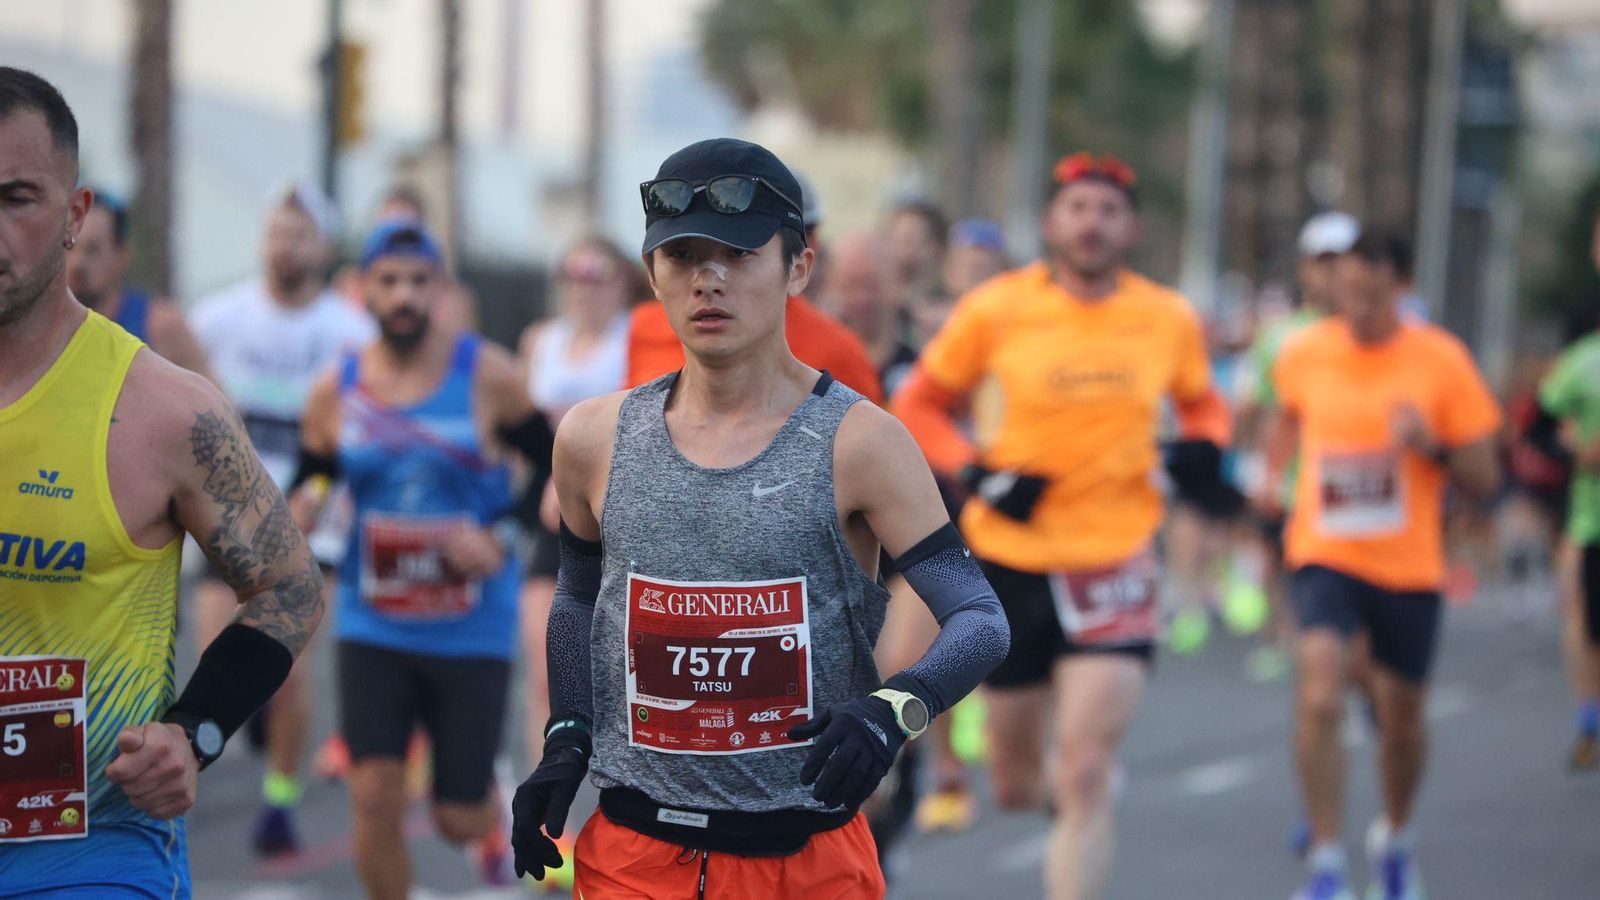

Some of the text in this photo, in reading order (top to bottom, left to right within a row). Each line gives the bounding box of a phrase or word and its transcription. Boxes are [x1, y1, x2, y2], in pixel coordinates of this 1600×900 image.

[18, 482, 74, 499] amura
[0, 532, 85, 571] TIVA
[667, 590, 791, 616] GENERALI
[666, 645, 756, 677] 7577
[692, 681, 732, 692] TATSU
[748, 710, 782, 723] 42K
[3, 722, 26, 756] 5
[17, 794, 55, 809] 42K
